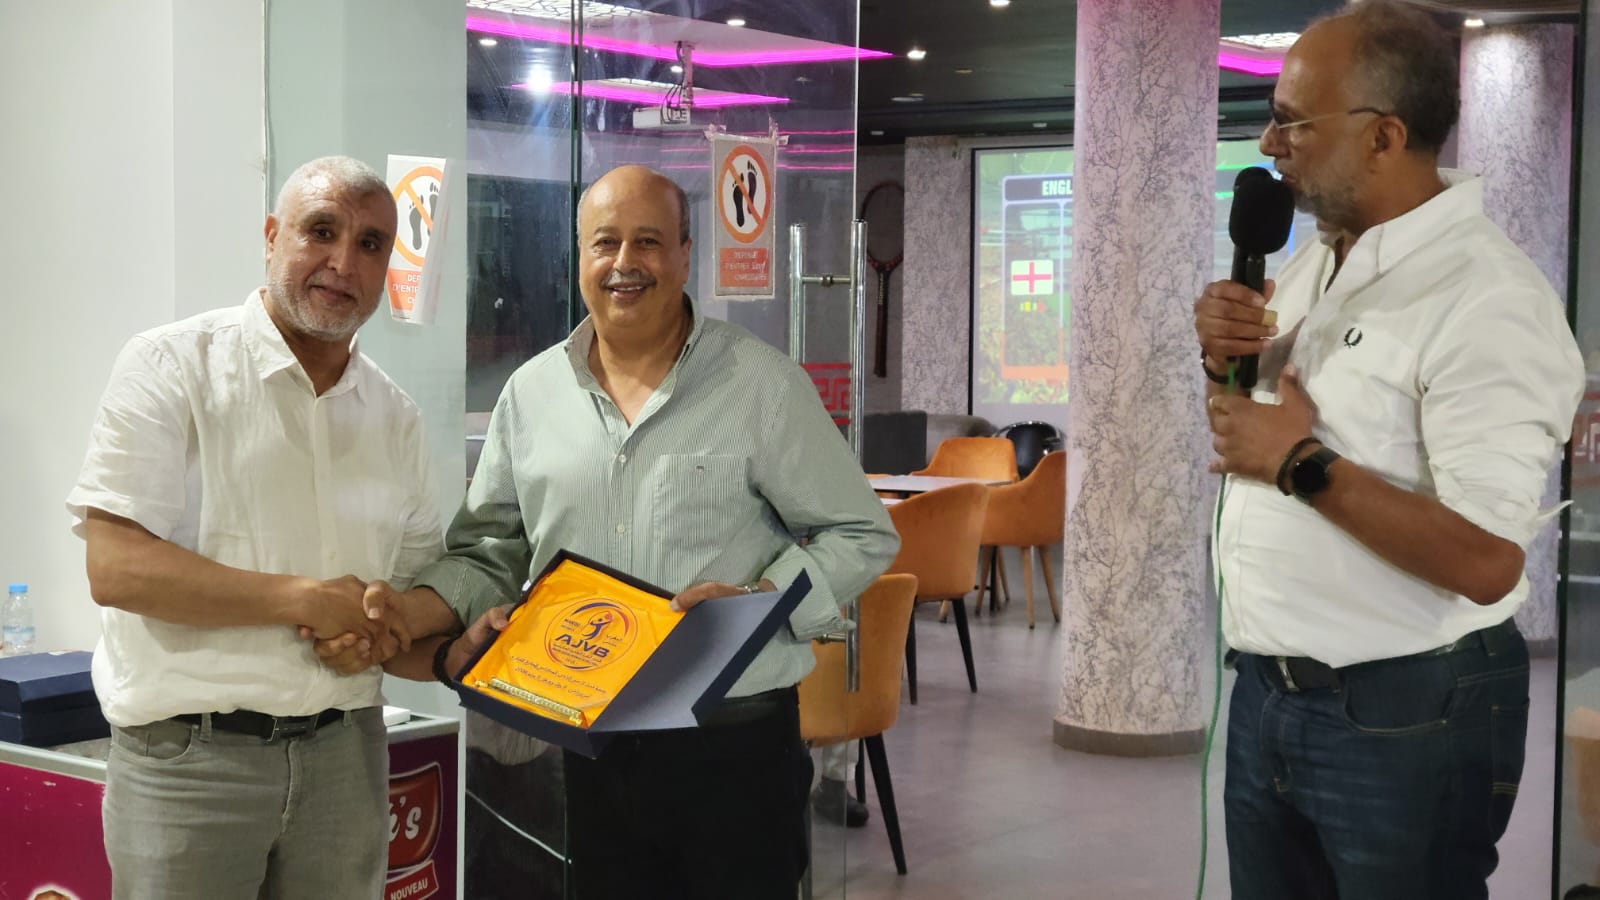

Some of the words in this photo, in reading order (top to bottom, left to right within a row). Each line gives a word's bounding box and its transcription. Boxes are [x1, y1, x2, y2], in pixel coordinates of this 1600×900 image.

[1042, 180, 1073, 195] ENGL
[555, 633, 610, 658] AJVB
[390, 877, 429, 900] NOUVEAU
